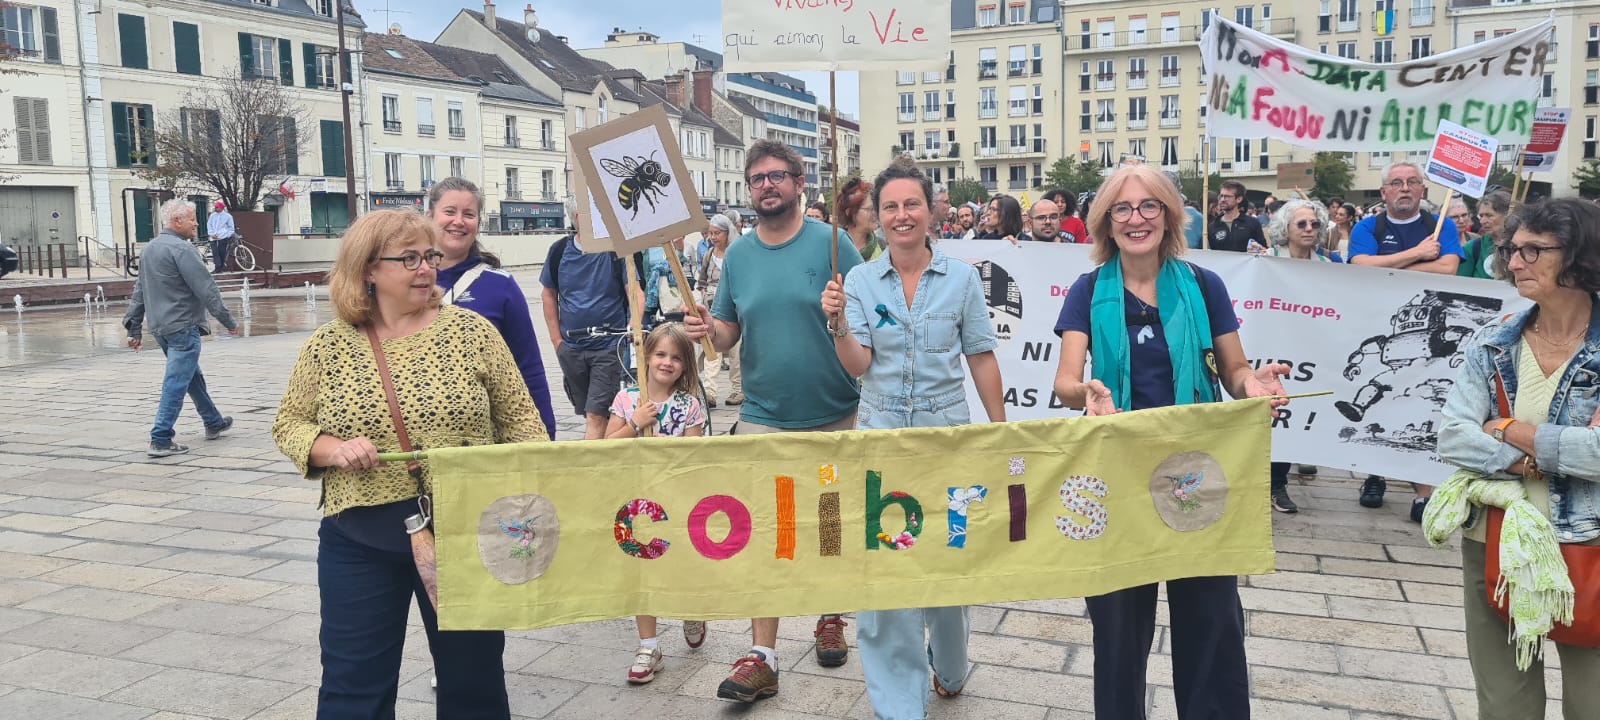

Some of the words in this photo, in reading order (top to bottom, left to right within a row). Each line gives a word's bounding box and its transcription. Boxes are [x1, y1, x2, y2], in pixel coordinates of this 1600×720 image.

[725, 29, 758, 61] qui
[841, 24, 861, 45] la
[868, 8, 929, 45] Vie
[1304, 59, 1387, 92] DATA
[1243, 300, 1264, 310] en
[1269, 297, 1342, 321] Europe,
[1021, 341, 1053, 362] NI
[1003, 387, 1038, 408] AS
[614, 457, 1109, 561] colibris
